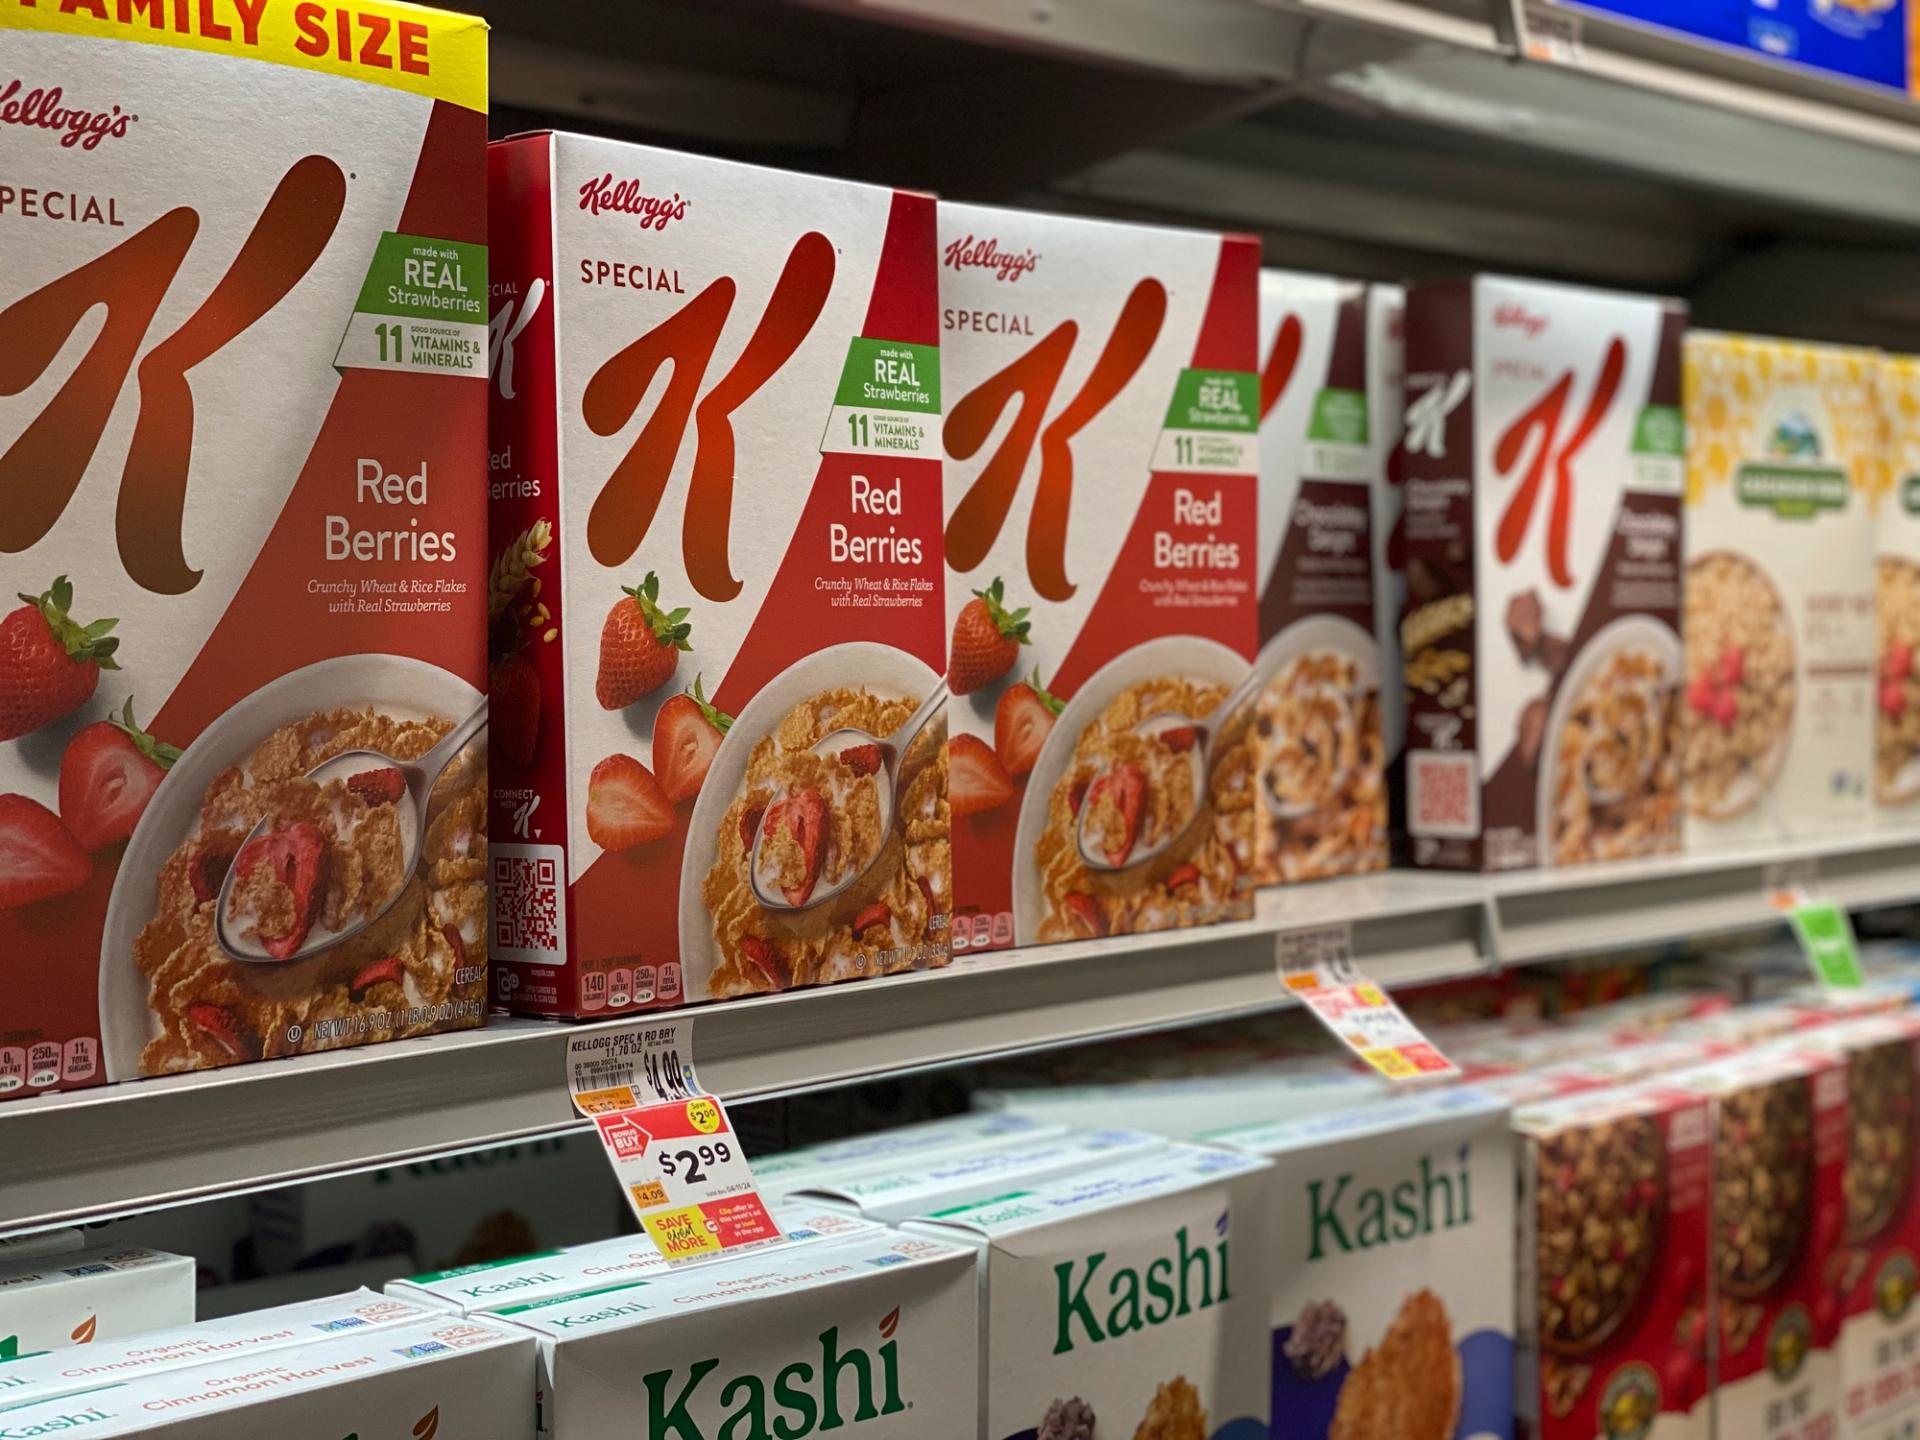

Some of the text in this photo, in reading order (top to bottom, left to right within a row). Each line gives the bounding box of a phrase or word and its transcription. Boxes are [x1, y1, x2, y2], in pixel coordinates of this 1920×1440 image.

[20, 0, 430, 76] MILY SIZE
[579, 173, 686, 231] Kellogg's
[413, 246, 459, 260] made with
[944, 234, 1037, 282] Kellogg's
[404, 258, 468, 292] REAL
[581, 259, 685, 294] SPECIAL
[388, 285, 480, 313] Strawberries
[430, 327, 451, 335] SOURCE
[944, 309, 1034, 336] SPECIAL
[374, 323, 402, 362] 11
[411, 335, 481, 354] VITAMINS &
[880, 348, 913, 360] made with
[411, 352, 473, 369] MINERALS
[875, 359, 920, 386] REAL
[864, 383, 929, 403] Strawberries
[1199, 386, 1242, 412] REAL
[582, 231, 836, 602] K
[848, 413, 868, 447] 11
[874, 422, 925, 438] VITAMINS &
[942, 276, 1167, 601] K
[875, 437, 919, 450] MINERALS
[1175, 436, 1192, 464] 11
[357, 458, 427, 505] Red
[851, 475, 901, 515] Red
[1174, 489, 1221, 525] Red
[325, 515, 456, 562] Berries
[830, 523, 922, 564] Berries
[1155, 531, 1240, 569] Berries
[307, 579, 467, 597] Crunchy Wheat & Rice Flakes
[815, 577, 934, 594] Crunchy Wheat & Rice Flakes
[329, 598, 452, 613] with Real Strawberries
[831, 594, 922, 607] with Real Strawberries
[493, 789, 534, 800] CONNECT
[455, 966, 482, 985] CEREAL
[585, 975, 604, 992] 140
[314, 1020, 332, 1040] NET
[334, 1018, 351, 1036] WT
[353, 1015, 376, 1033] 16.9
[378, 1012, 392, 1030] OZ
[572, 1027, 676, 1052] KELLOGG SPEC K RD BRY
[606, 1043, 642, 1057] 11.70 OZ
[33, 1060, 58, 1071] SODIUM
[68, 1062, 92, 1073] SUGARS
[72, 1055, 89, 1064] TOTAL
[614, 1135, 639, 1148] BUY
[719, 1207, 732, 1216] Clip
[733, 1205, 747, 1213] offer
[1305, 1142, 1474, 1262] Kashi
[656, 1214, 692, 1231] SAVE
[666, 1224, 696, 1240] even
[751, 1226, 764, 1234] app
[666, 1235, 708, 1253] MORE
[461, 1270, 557, 1297] Kashi
[673, 1263, 854, 1305] Cinnamon Harvest
[716, 1270, 783, 1288] Organic
[1053, 1209, 1230, 1355] Kashi
[549, 1300, 649, 1328] Kashi
[61, 1330, 295, 1378] Cinnamon Harvest
[126, 1338, 208, 1357] Organic
[143, 1355, 377, 1411] Cinnamon Harvest
[205, 1365, 289, 1387] Organic
[643, 1306, 905, 1440] Kashi
